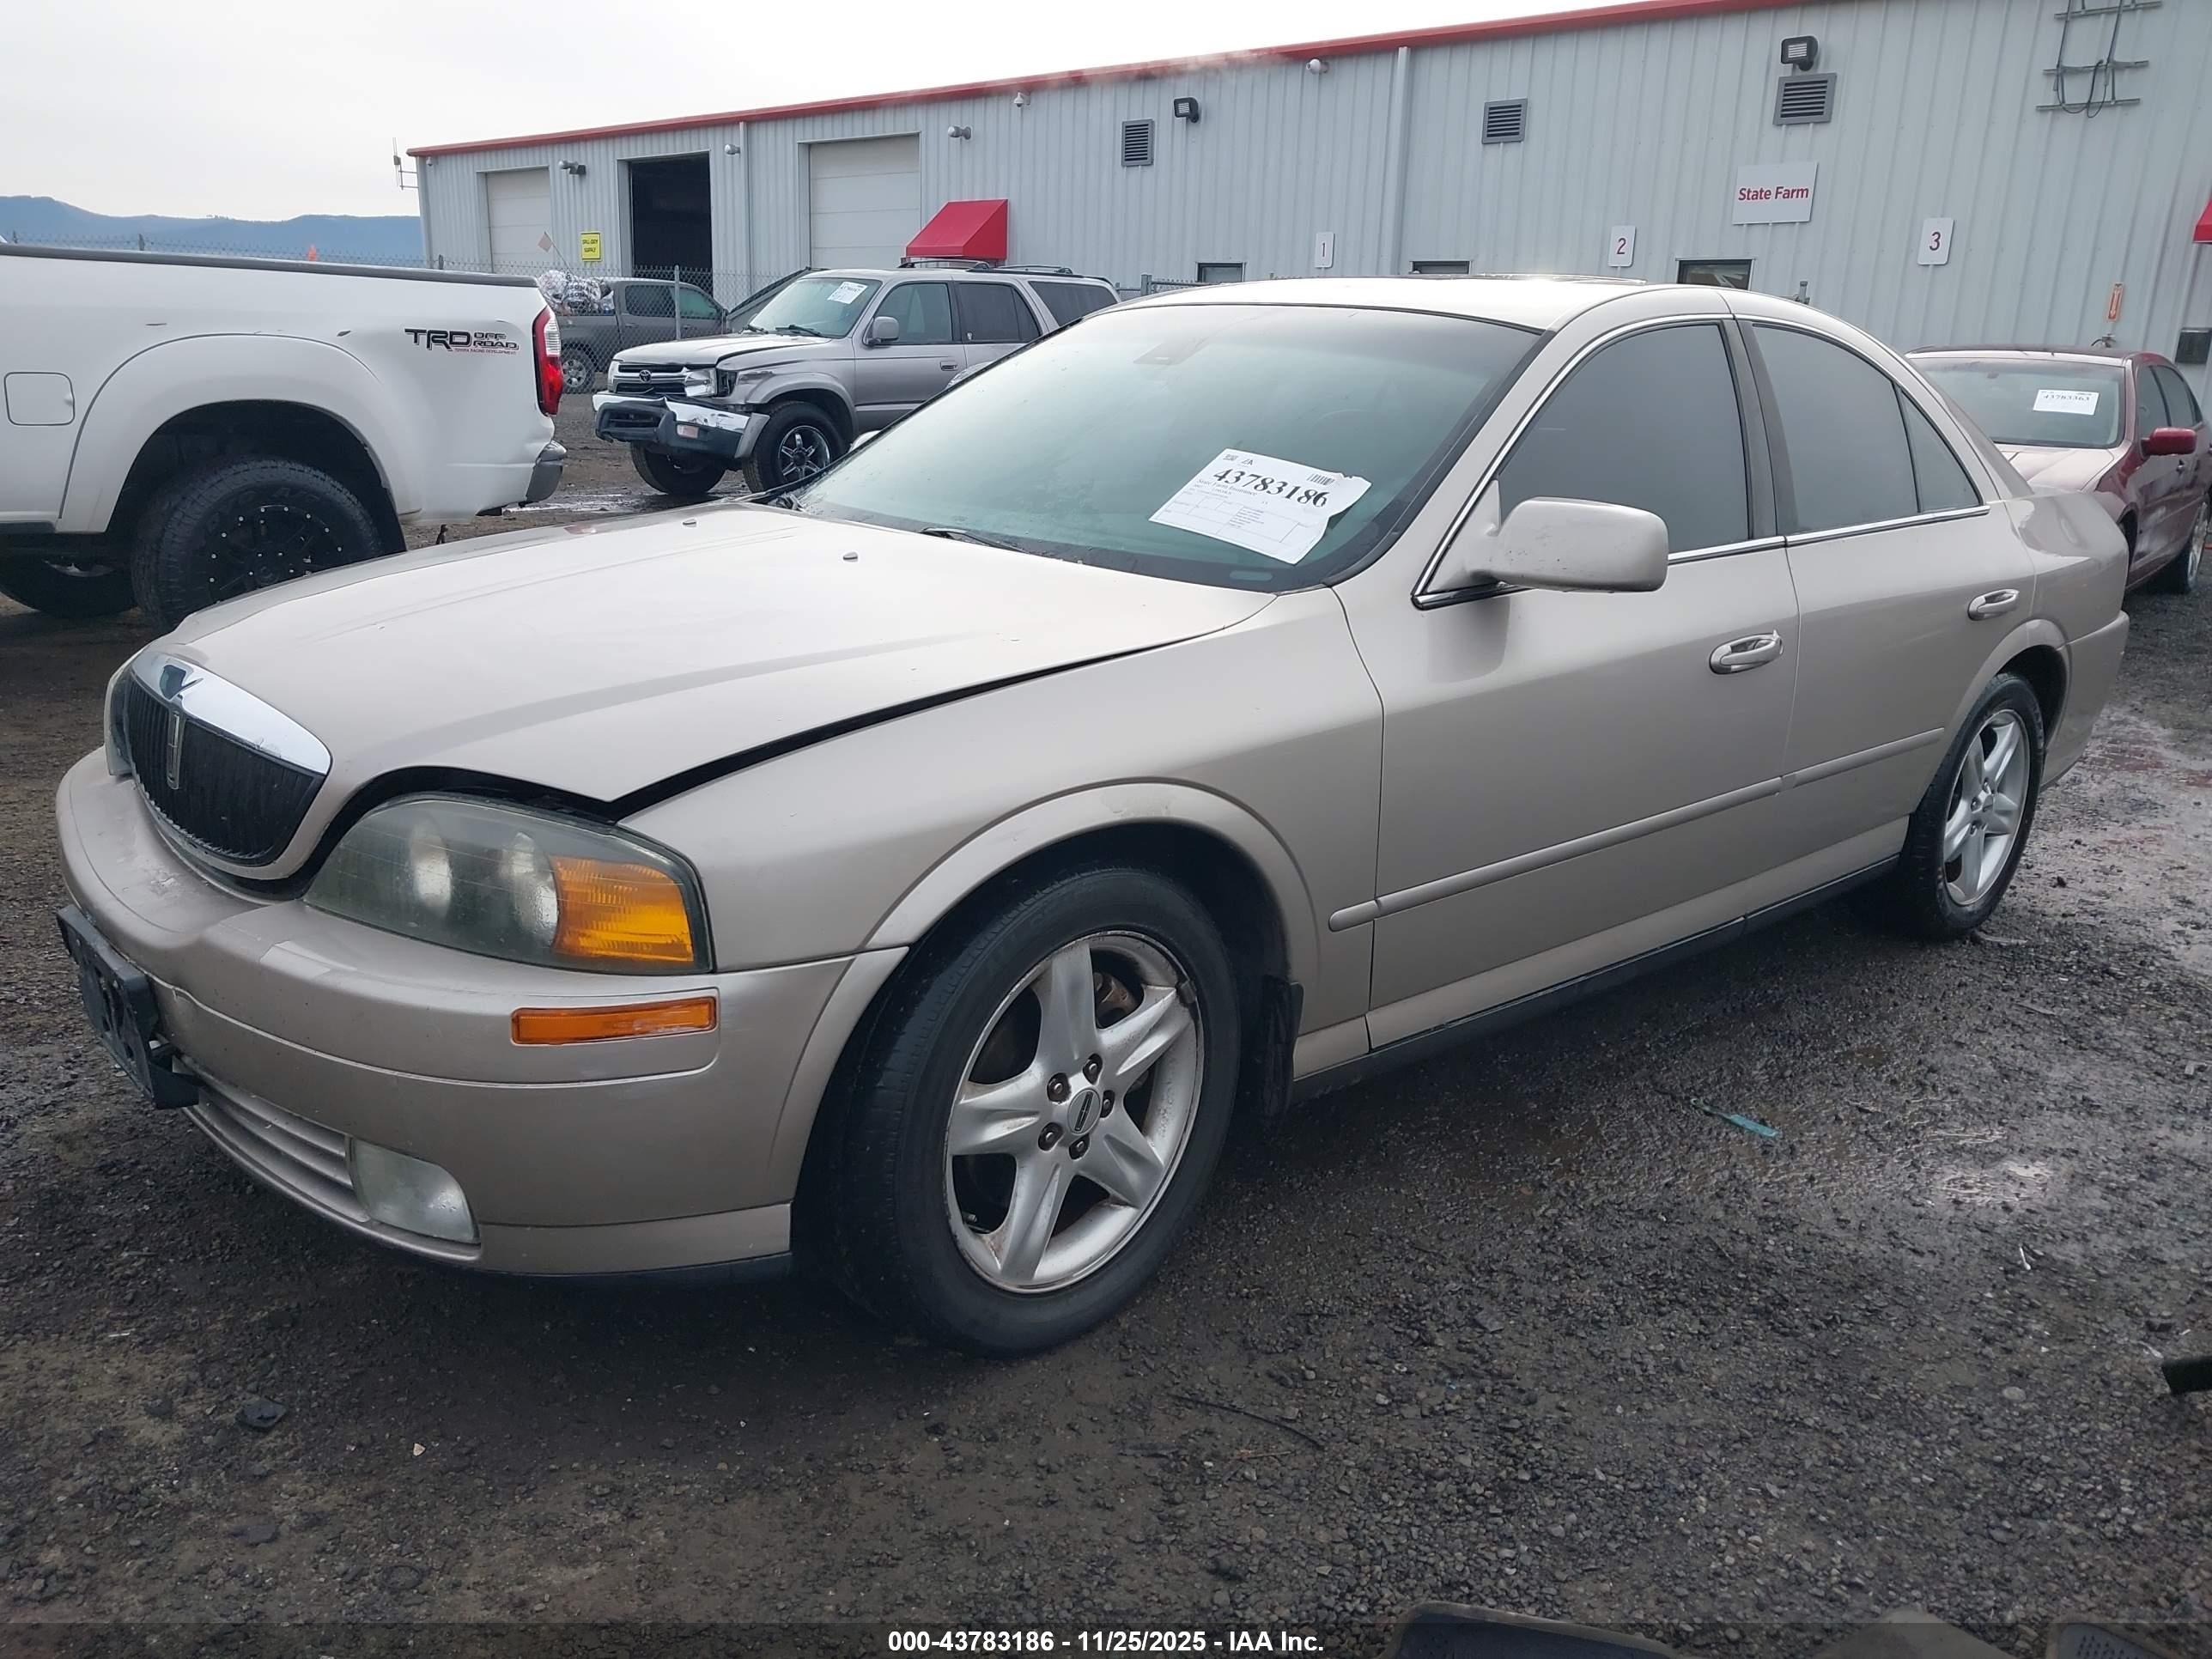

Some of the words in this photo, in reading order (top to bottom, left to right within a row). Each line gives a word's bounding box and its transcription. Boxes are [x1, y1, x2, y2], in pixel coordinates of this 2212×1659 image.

[1738, 187, 1771, 201] State
[1774, 185, 1809, 200] Farm
[1616, 237, 1626, 255] 2
[1929, 231, 1941, 252] 3
[404, 328, 472, 352] TRD
[473, 331, 507, 341] OFF
[473, 340, 519, 350] ROAD
[1213, 468, 1330, 508] 43783186
